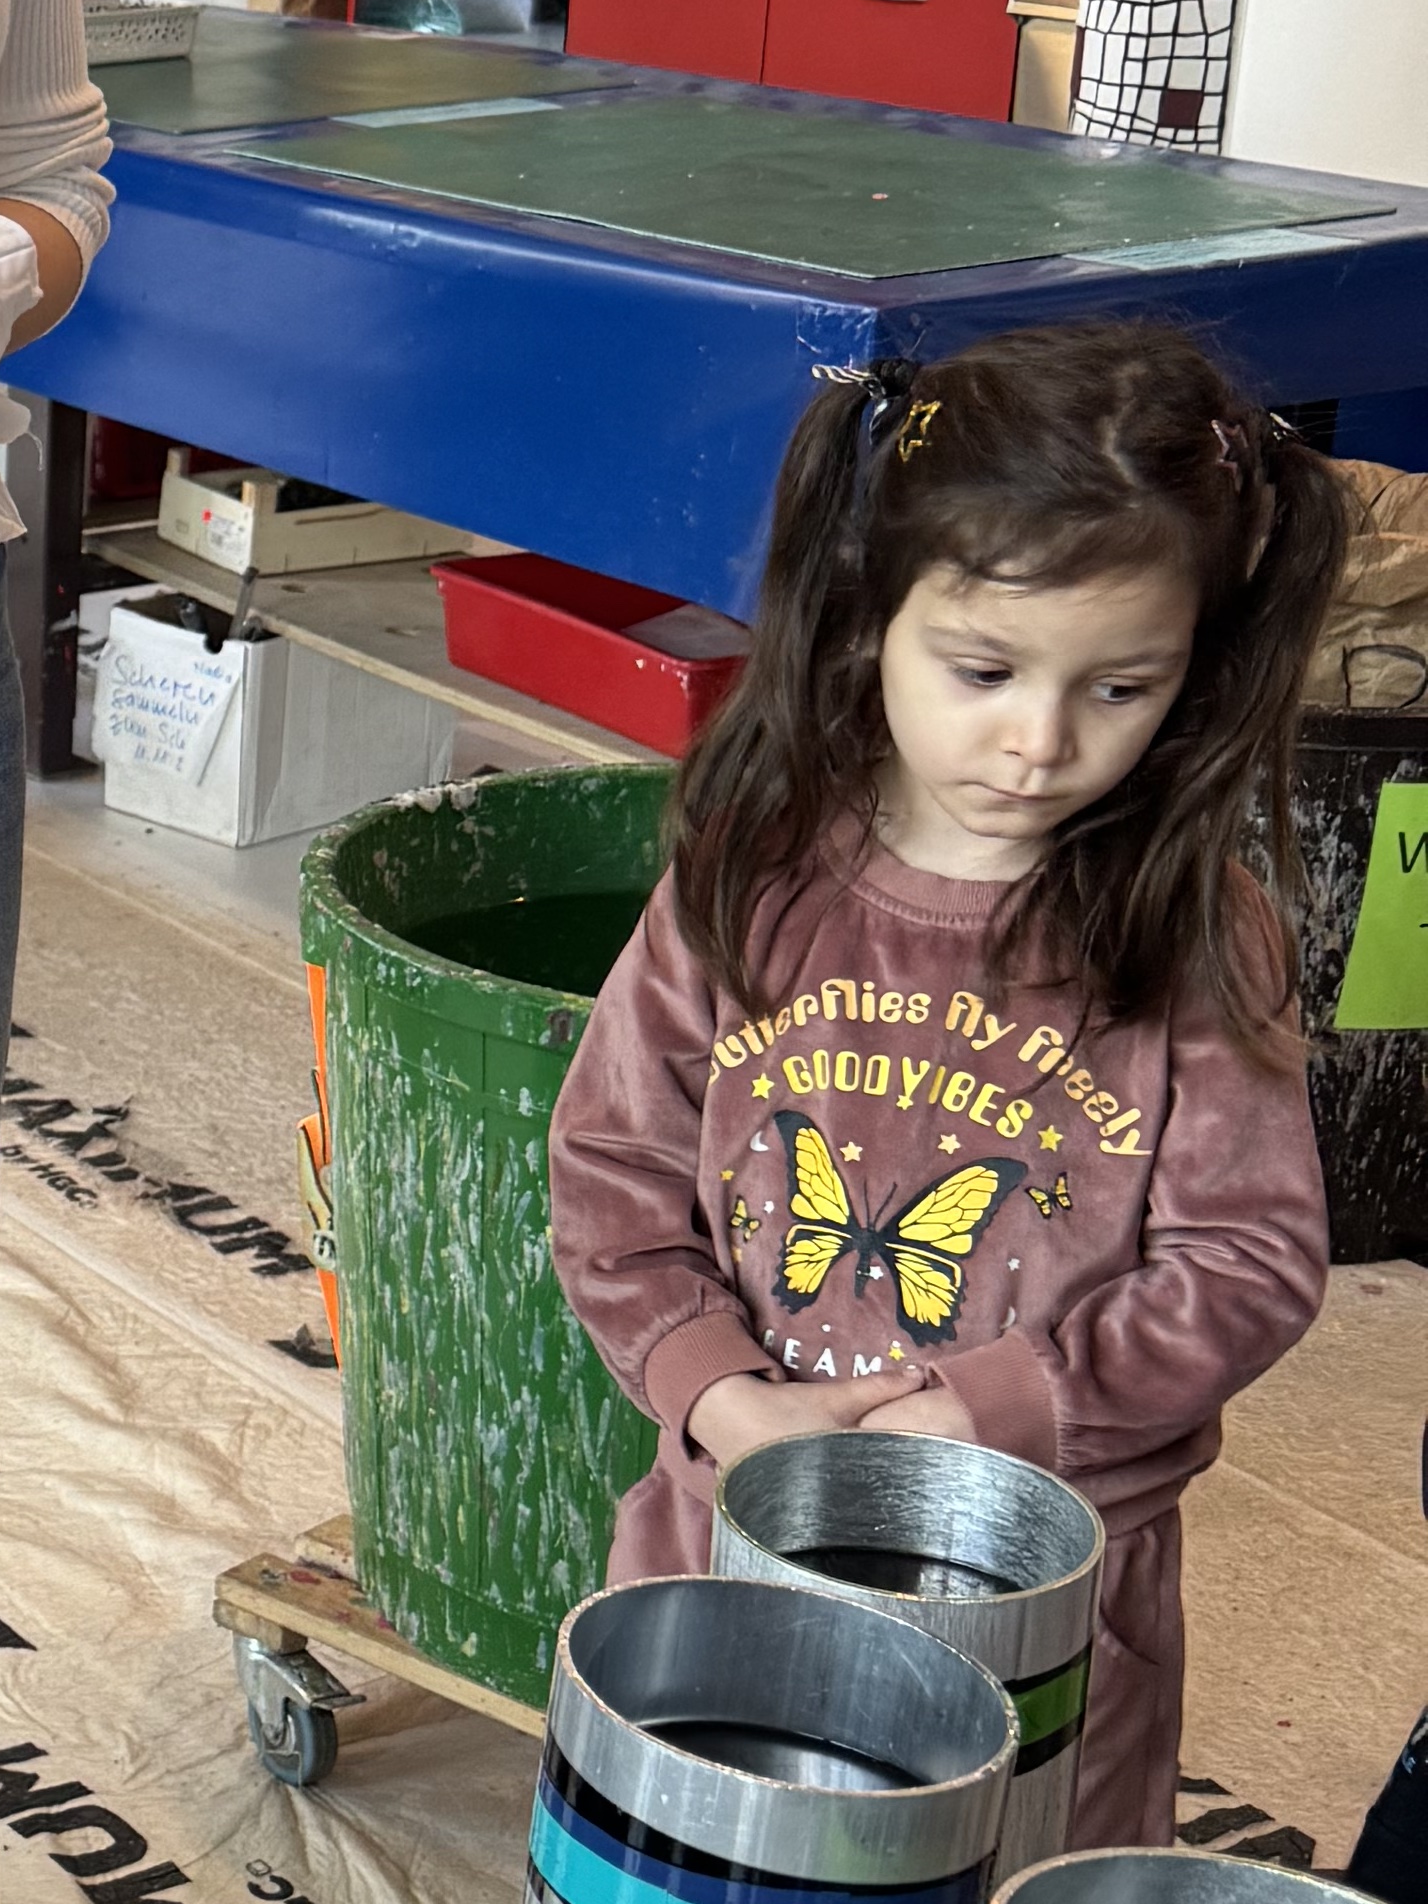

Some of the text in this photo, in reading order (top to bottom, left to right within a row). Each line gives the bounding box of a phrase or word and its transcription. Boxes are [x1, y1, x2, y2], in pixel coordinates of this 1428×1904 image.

[111, 654, 217, 706] Scheren
[782, 1049, 1034, 1139] GOOD VIBES
[944, 990, 1018, 1052] fly
[1017, 1024, 1153, 1157] freely
